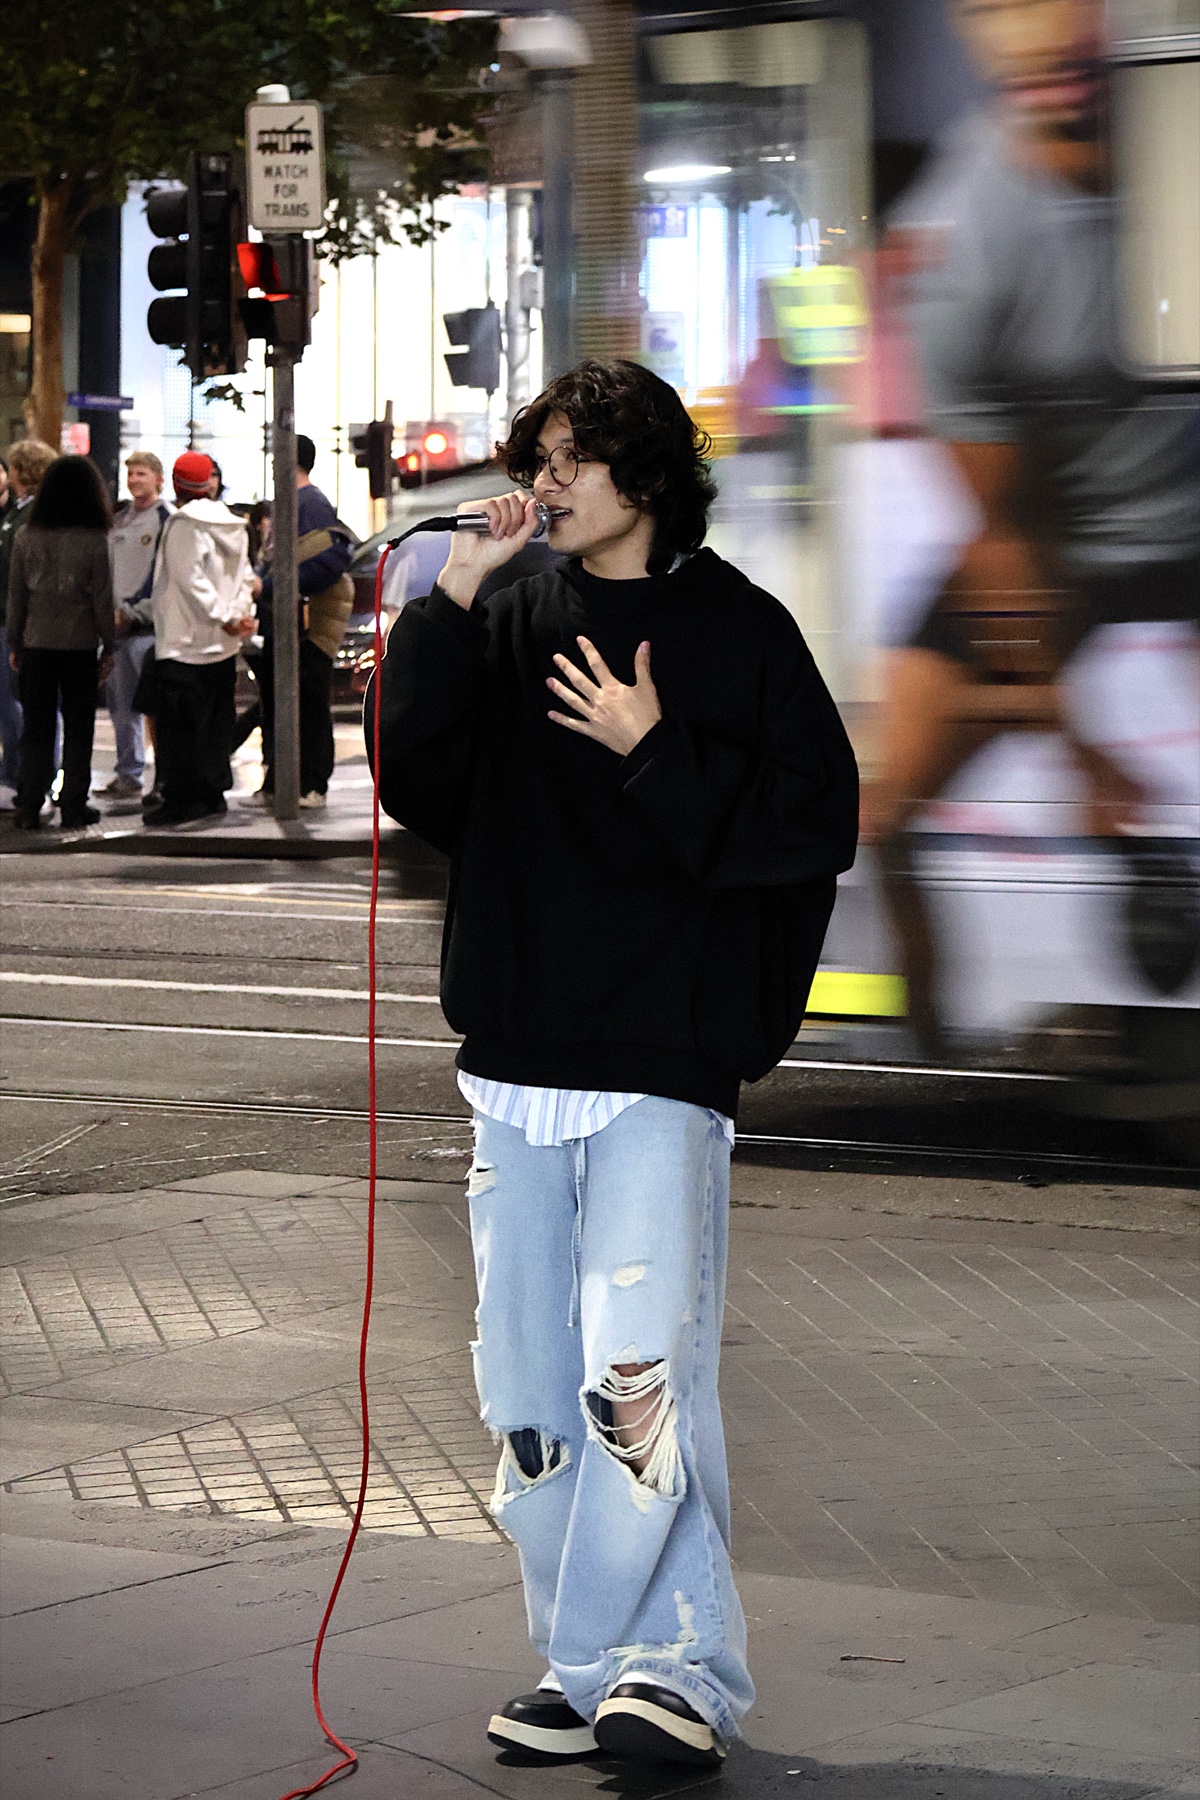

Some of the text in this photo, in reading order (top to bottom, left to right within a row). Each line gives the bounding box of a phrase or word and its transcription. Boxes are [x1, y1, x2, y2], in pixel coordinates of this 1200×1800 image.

[264, 165, 309, 179] WATCH
[274, 183, 298, 198] FOR
[264, 203, 309, 217] TRAMS
